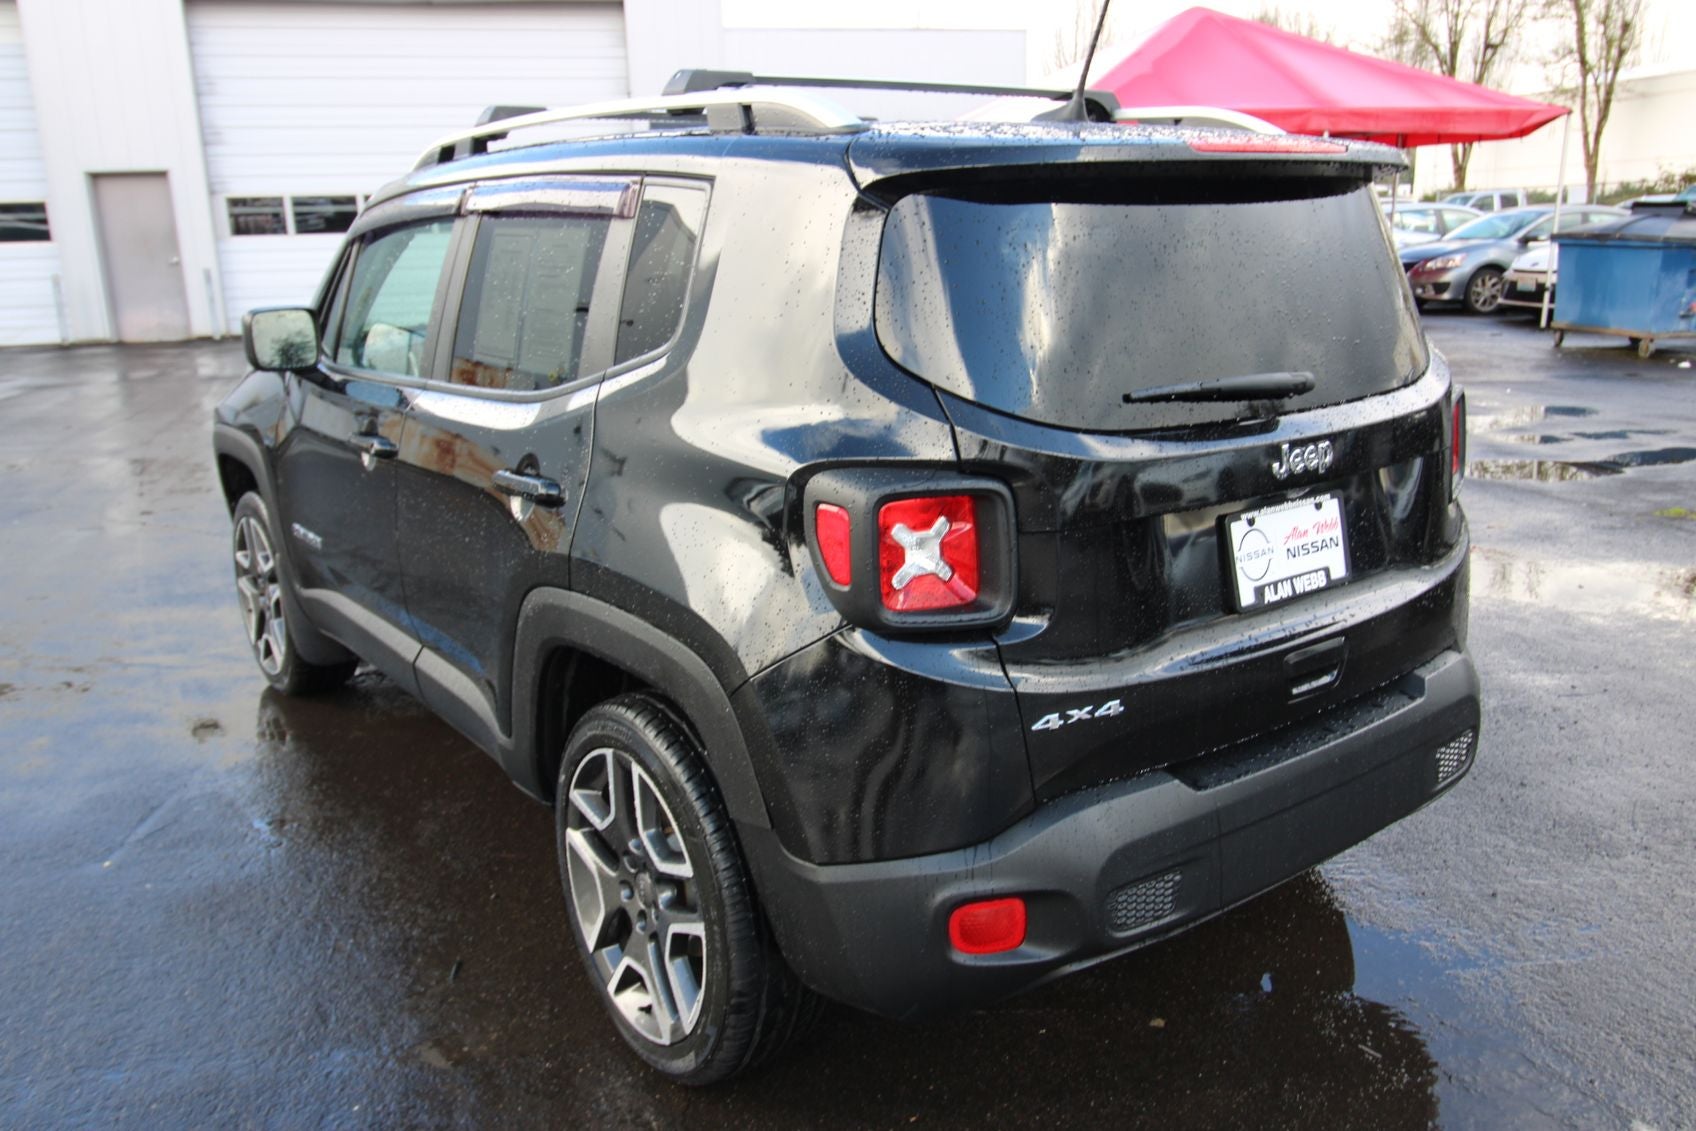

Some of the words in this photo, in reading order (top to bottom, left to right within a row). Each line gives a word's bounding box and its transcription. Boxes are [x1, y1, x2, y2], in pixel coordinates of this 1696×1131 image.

[1272, 440, 1334, 480] Jeep
[1284, 526, 1309, 545] Alan
[1235, 546, 1274, 563] NISSAN
[1286, 536, 1339, 560] NISSAN
[1264, 580, 1293, 603] ALAN
[1292, 570, 1327, 595] WEBB
